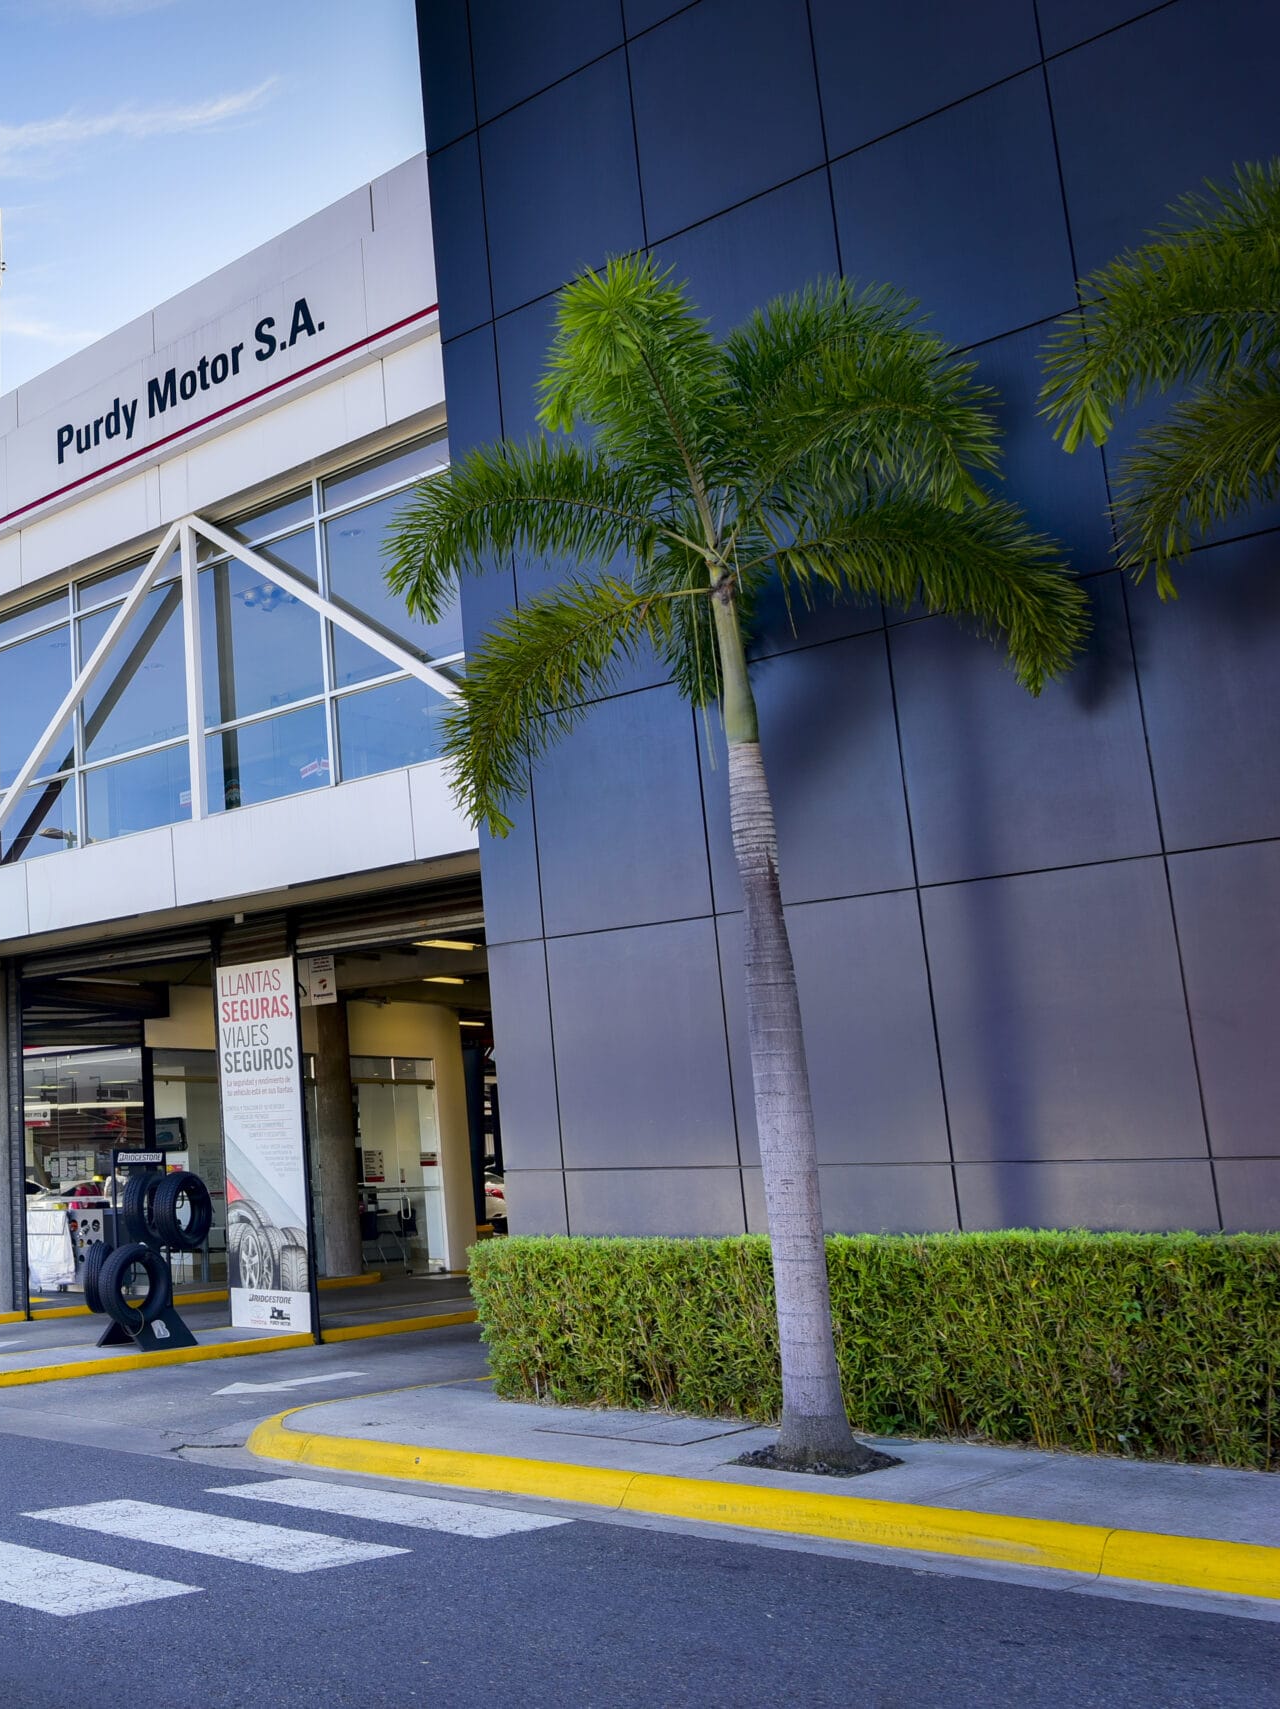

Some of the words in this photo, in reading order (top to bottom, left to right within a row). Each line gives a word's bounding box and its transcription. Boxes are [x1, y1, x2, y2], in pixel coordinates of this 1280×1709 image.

[56, 397, 139, 465] Purdy
[147, 342, 244, 419] Motor
[254, 297, 325, 362] S.A.
[220, 968, 281, 998] LLANTAS
[222, 994, 293, 1024] SEGURAS,
[223, 1023, 269, 1049] VIAJES
[224, 1046, 294, 1074] SEGUROS
[119, 1152, 163, 1163] BRIDGESTONE
[248, 1293, 292, 1305] BRIDGESTONE
